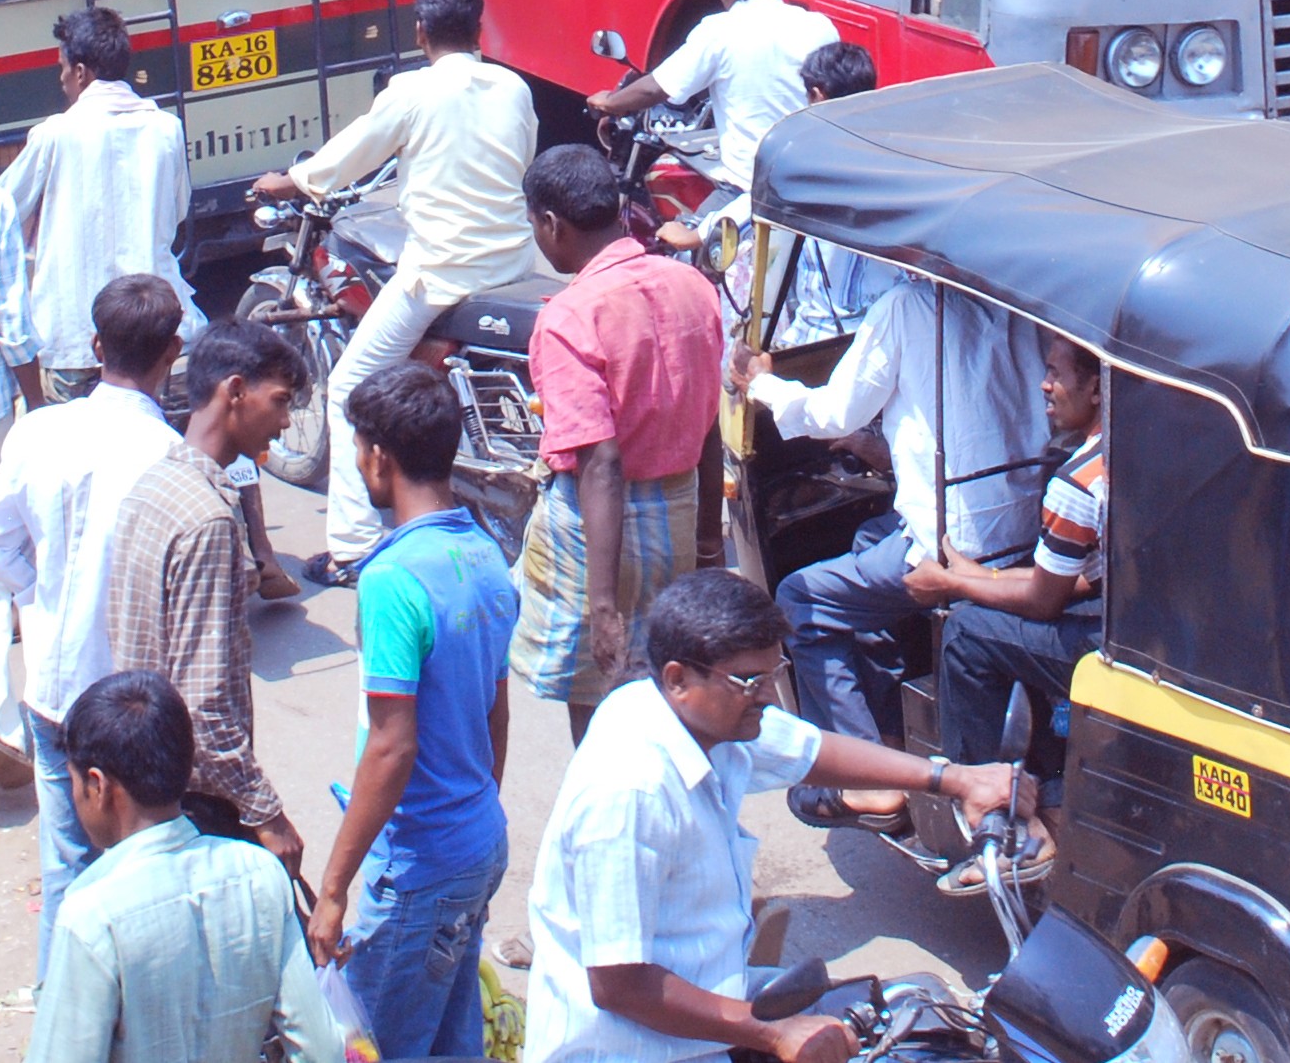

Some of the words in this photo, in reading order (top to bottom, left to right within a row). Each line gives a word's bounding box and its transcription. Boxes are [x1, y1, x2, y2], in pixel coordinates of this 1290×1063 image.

[200, 34, 268, 61] KA-16
[197, 54, 273, 86] 8480
[1107, 989, 1145, 1038] HONDA
